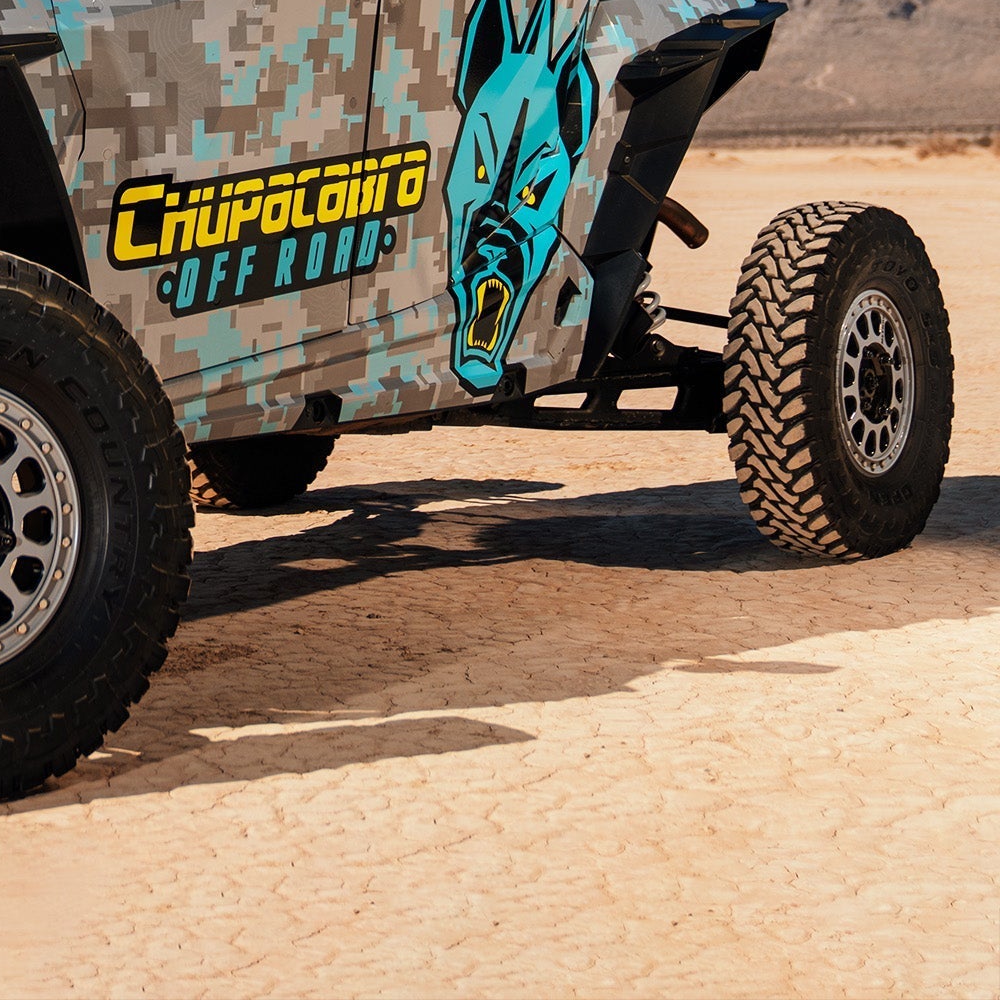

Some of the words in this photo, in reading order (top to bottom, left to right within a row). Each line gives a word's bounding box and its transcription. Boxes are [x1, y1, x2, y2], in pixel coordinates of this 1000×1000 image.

[175, 246, 257, 309] OFF
[274, 220, 381, 288] ROAD
[870, 258, 919, 292] TOYO
[56, 375, 133, 622] COUNTRY
